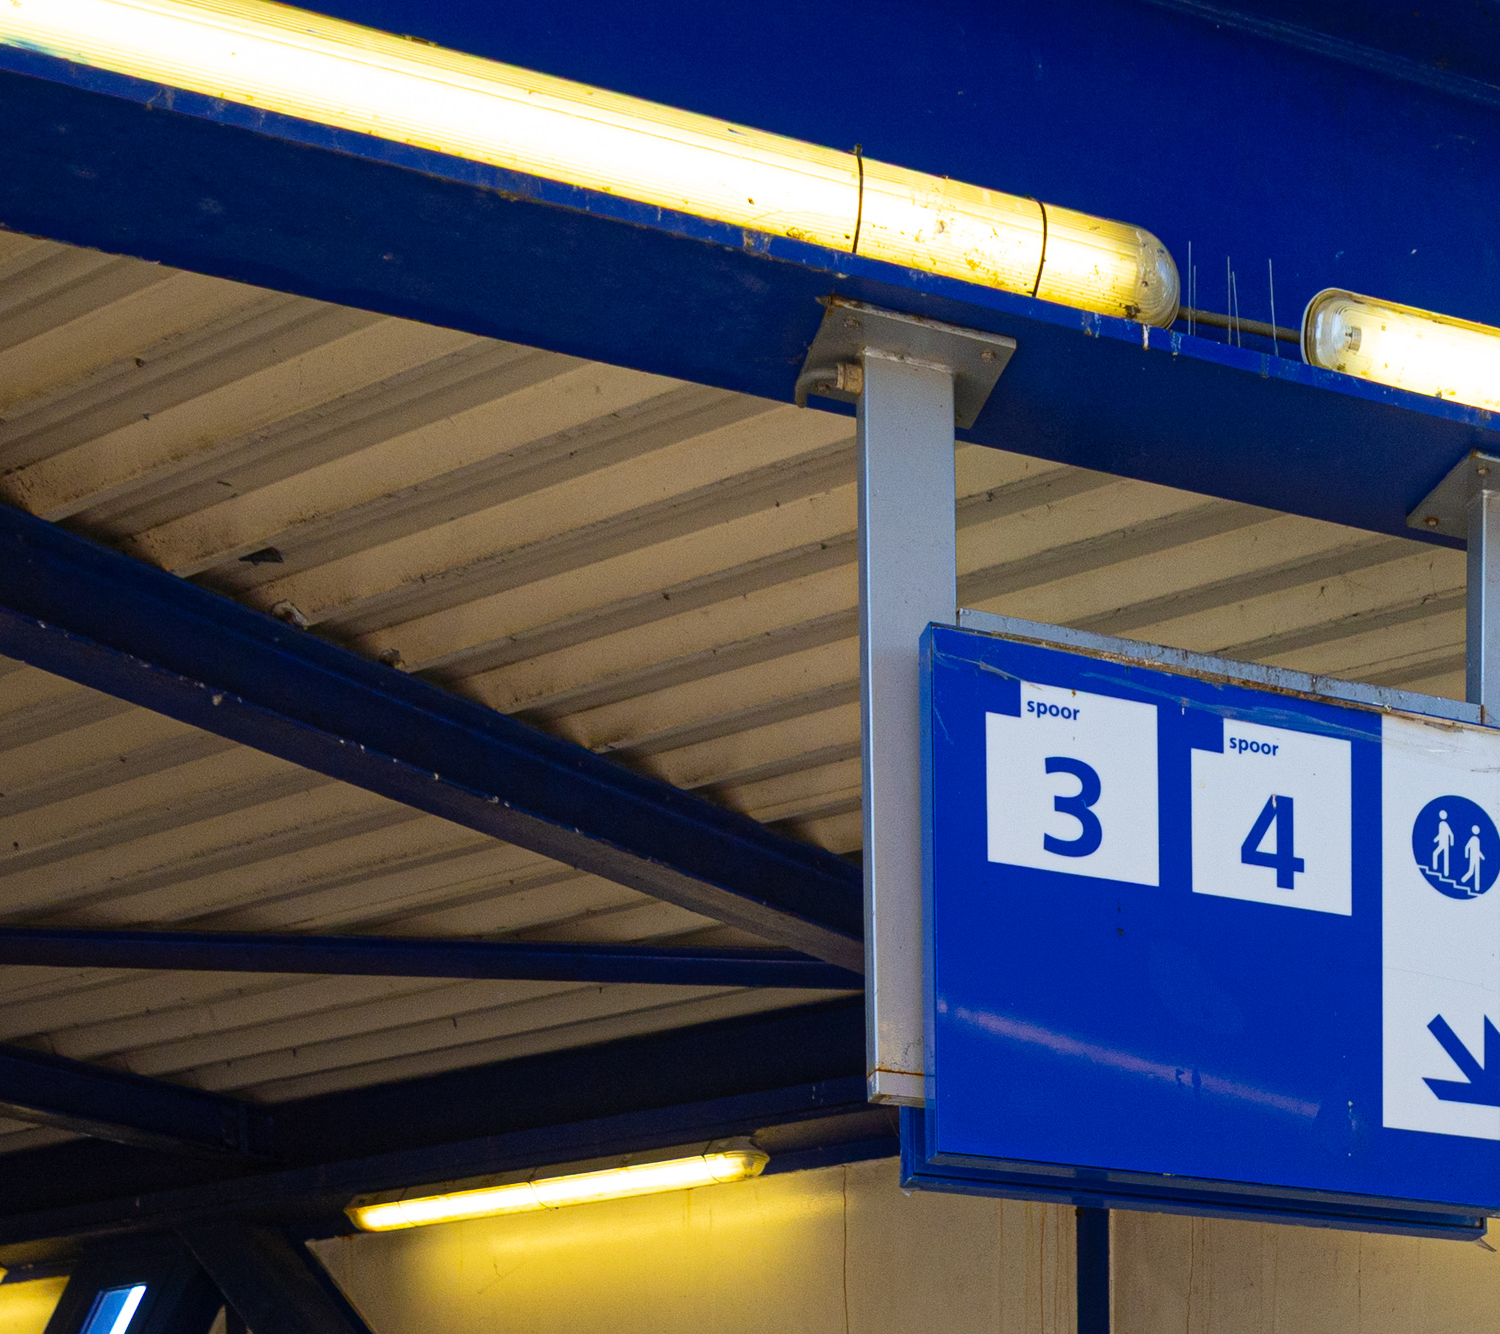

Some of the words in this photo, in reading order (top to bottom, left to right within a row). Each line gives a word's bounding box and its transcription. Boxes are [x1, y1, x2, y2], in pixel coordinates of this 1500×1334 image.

[1027, 698, 1080, 721] spoor
[1229, 736, 1279, 756] spoor
[1043, 756, 1103, 858] 3
[1241, 794, 1304, 890] 4
